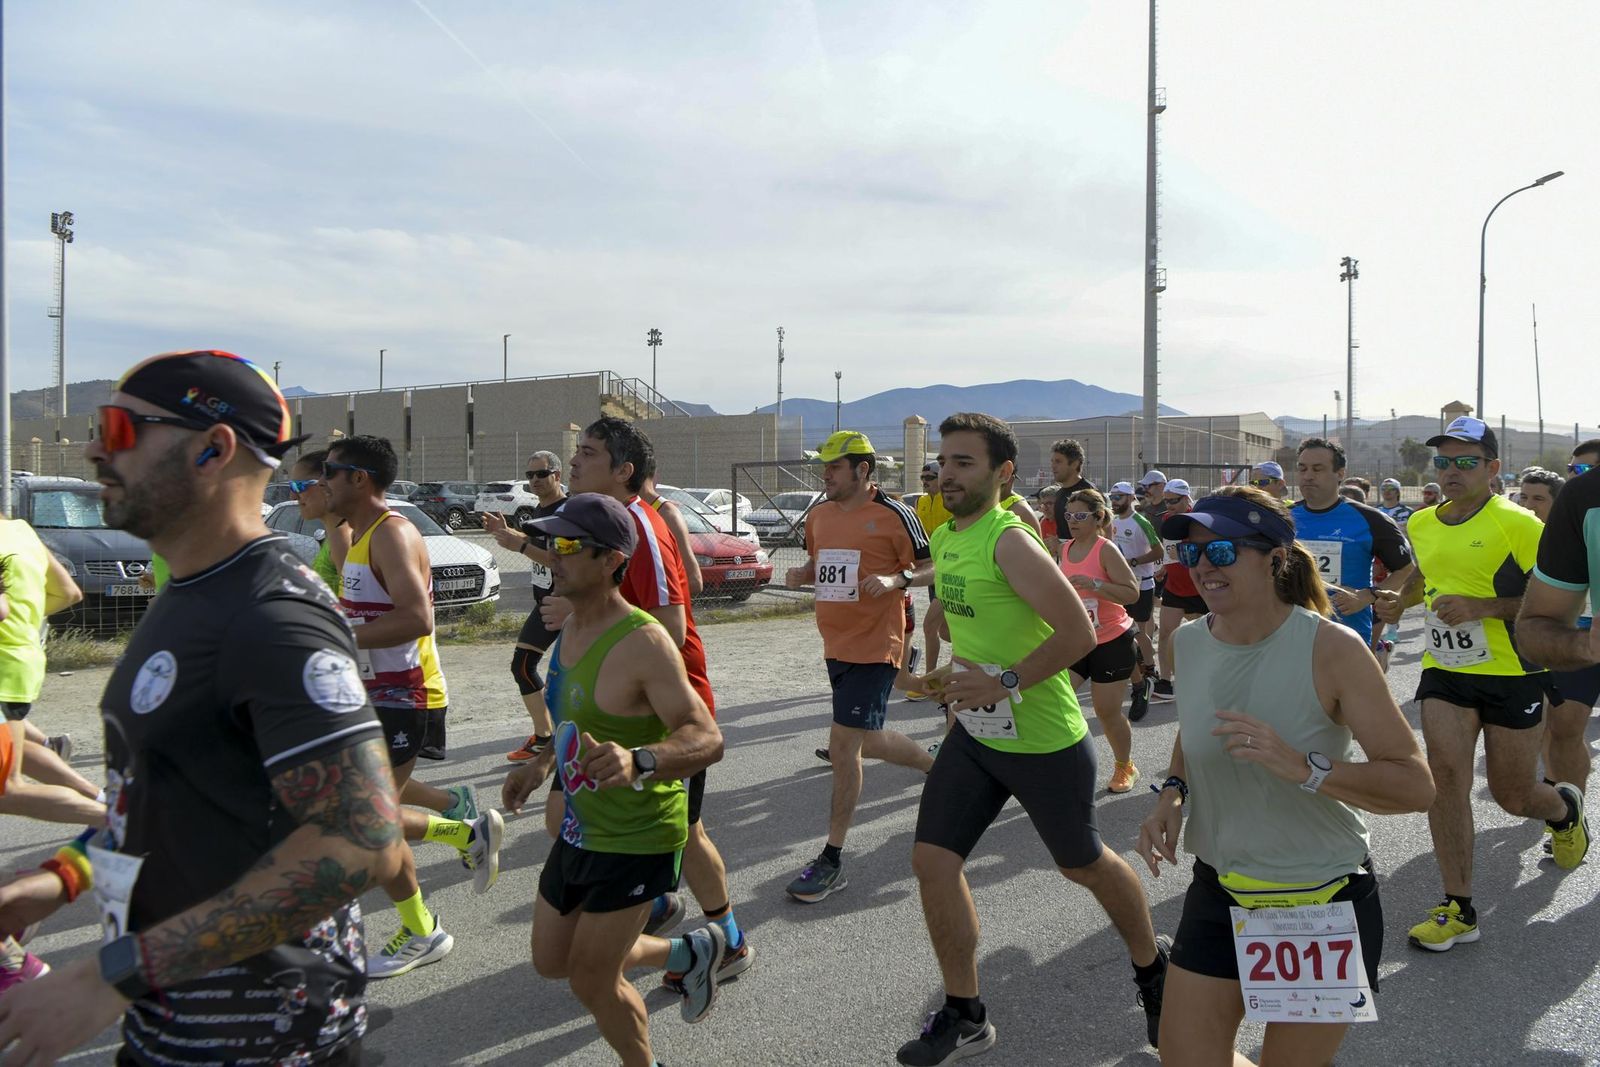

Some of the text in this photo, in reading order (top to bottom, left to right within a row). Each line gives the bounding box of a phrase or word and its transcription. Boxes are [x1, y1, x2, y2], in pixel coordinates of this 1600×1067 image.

[1315, 556, 1331, 573] 2
[819, 565, 847, 584] 881
[113, 585, 140, 595] 7684
[440, 581, 458, 590] 7011
[942, 584, 966, 603] PADRE
[1431, 628, 1474, 650] 918
[1246, 940, 1354, 982] 2017
